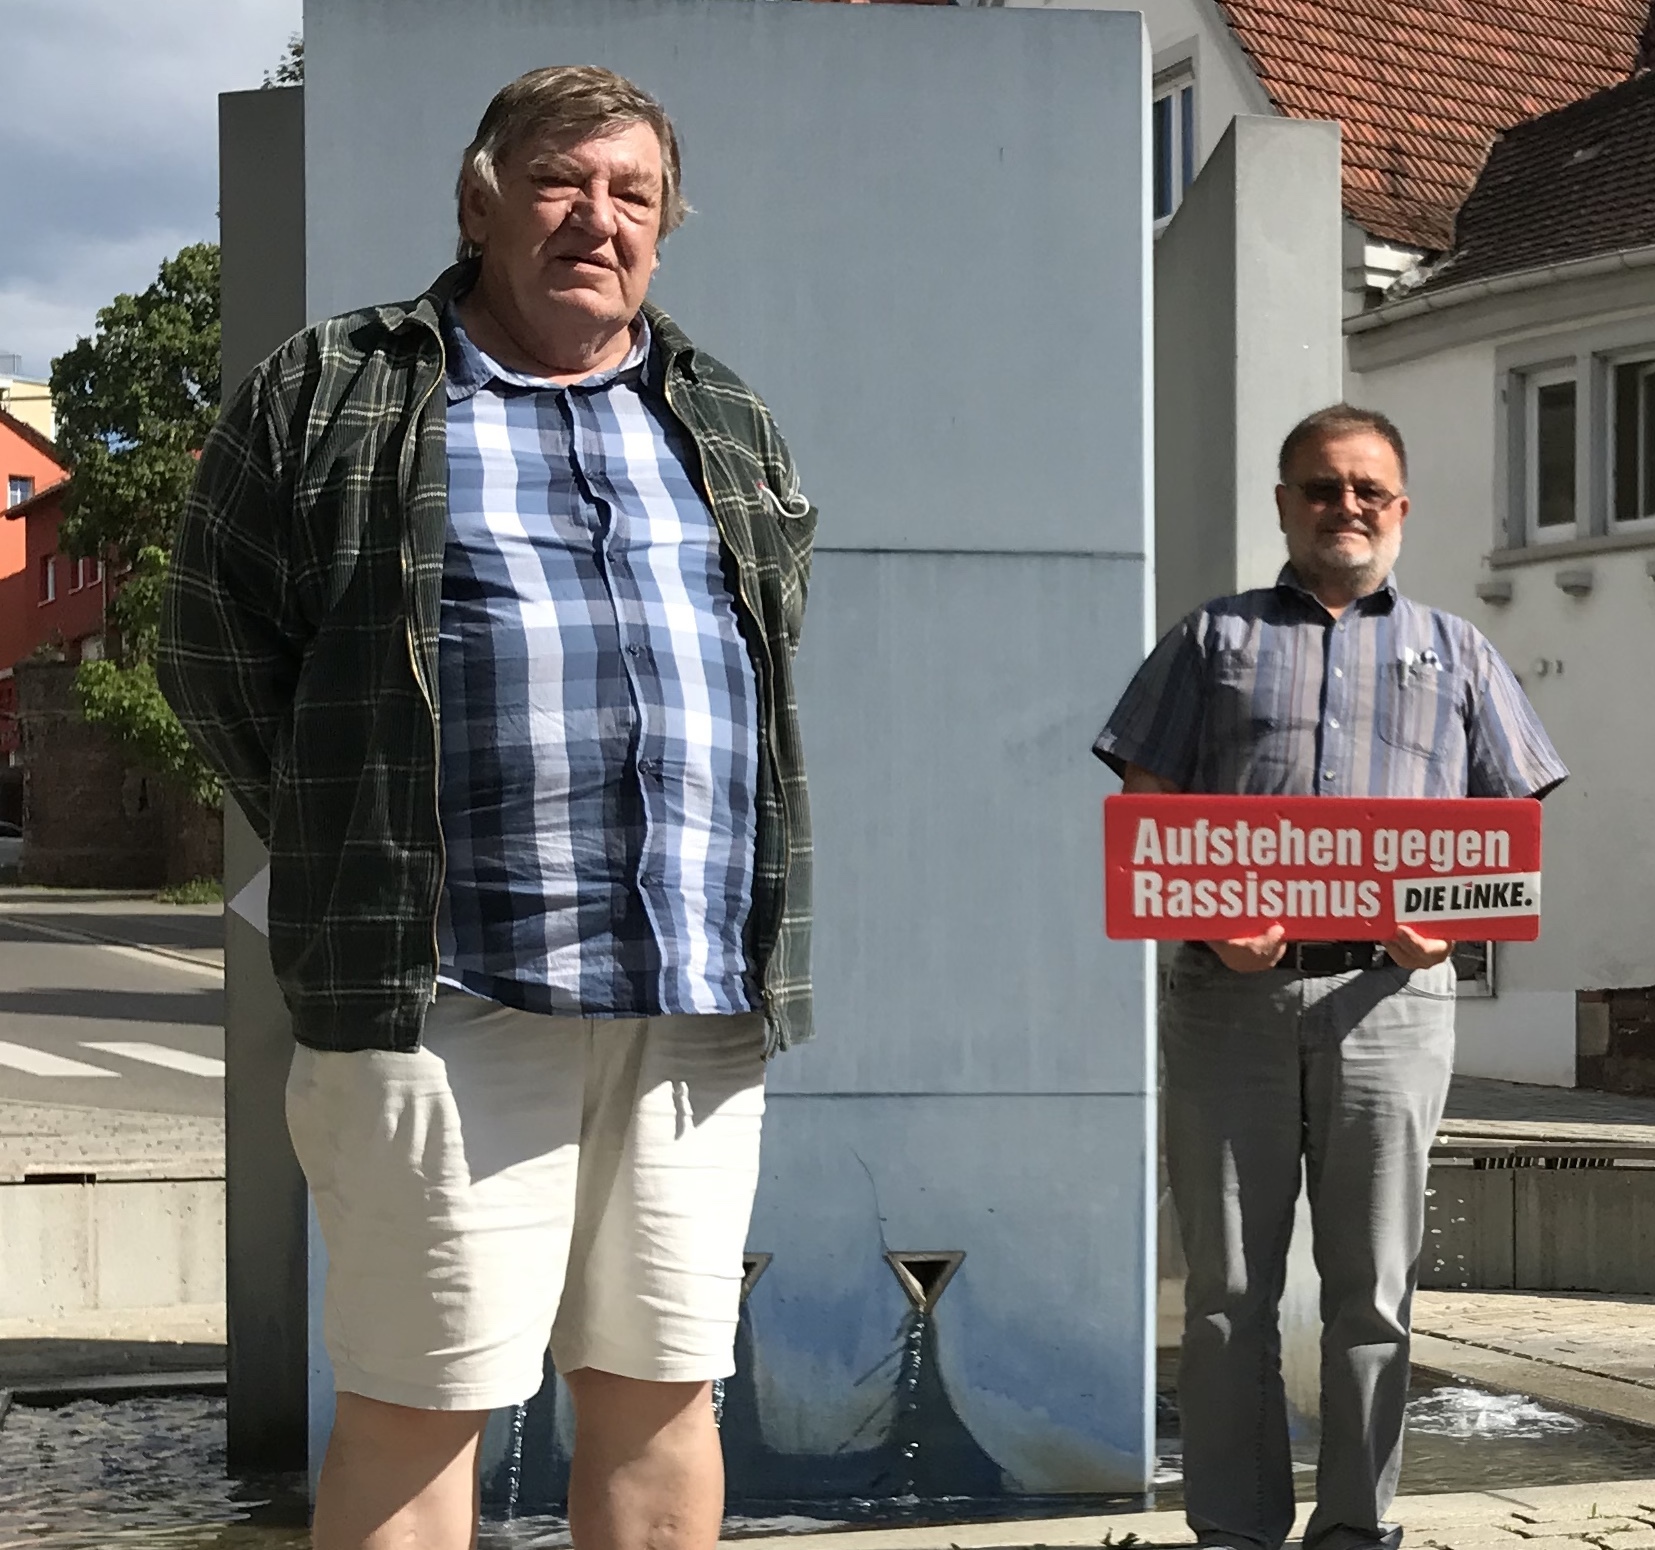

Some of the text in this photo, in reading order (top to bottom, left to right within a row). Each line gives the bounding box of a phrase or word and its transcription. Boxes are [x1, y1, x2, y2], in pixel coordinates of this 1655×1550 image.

[1132, 818, 1510, 873] Aufstehen gegen
[1132, 870, 1381, 918] Rassismus
[1405, 886, 1446, 913] DIE
